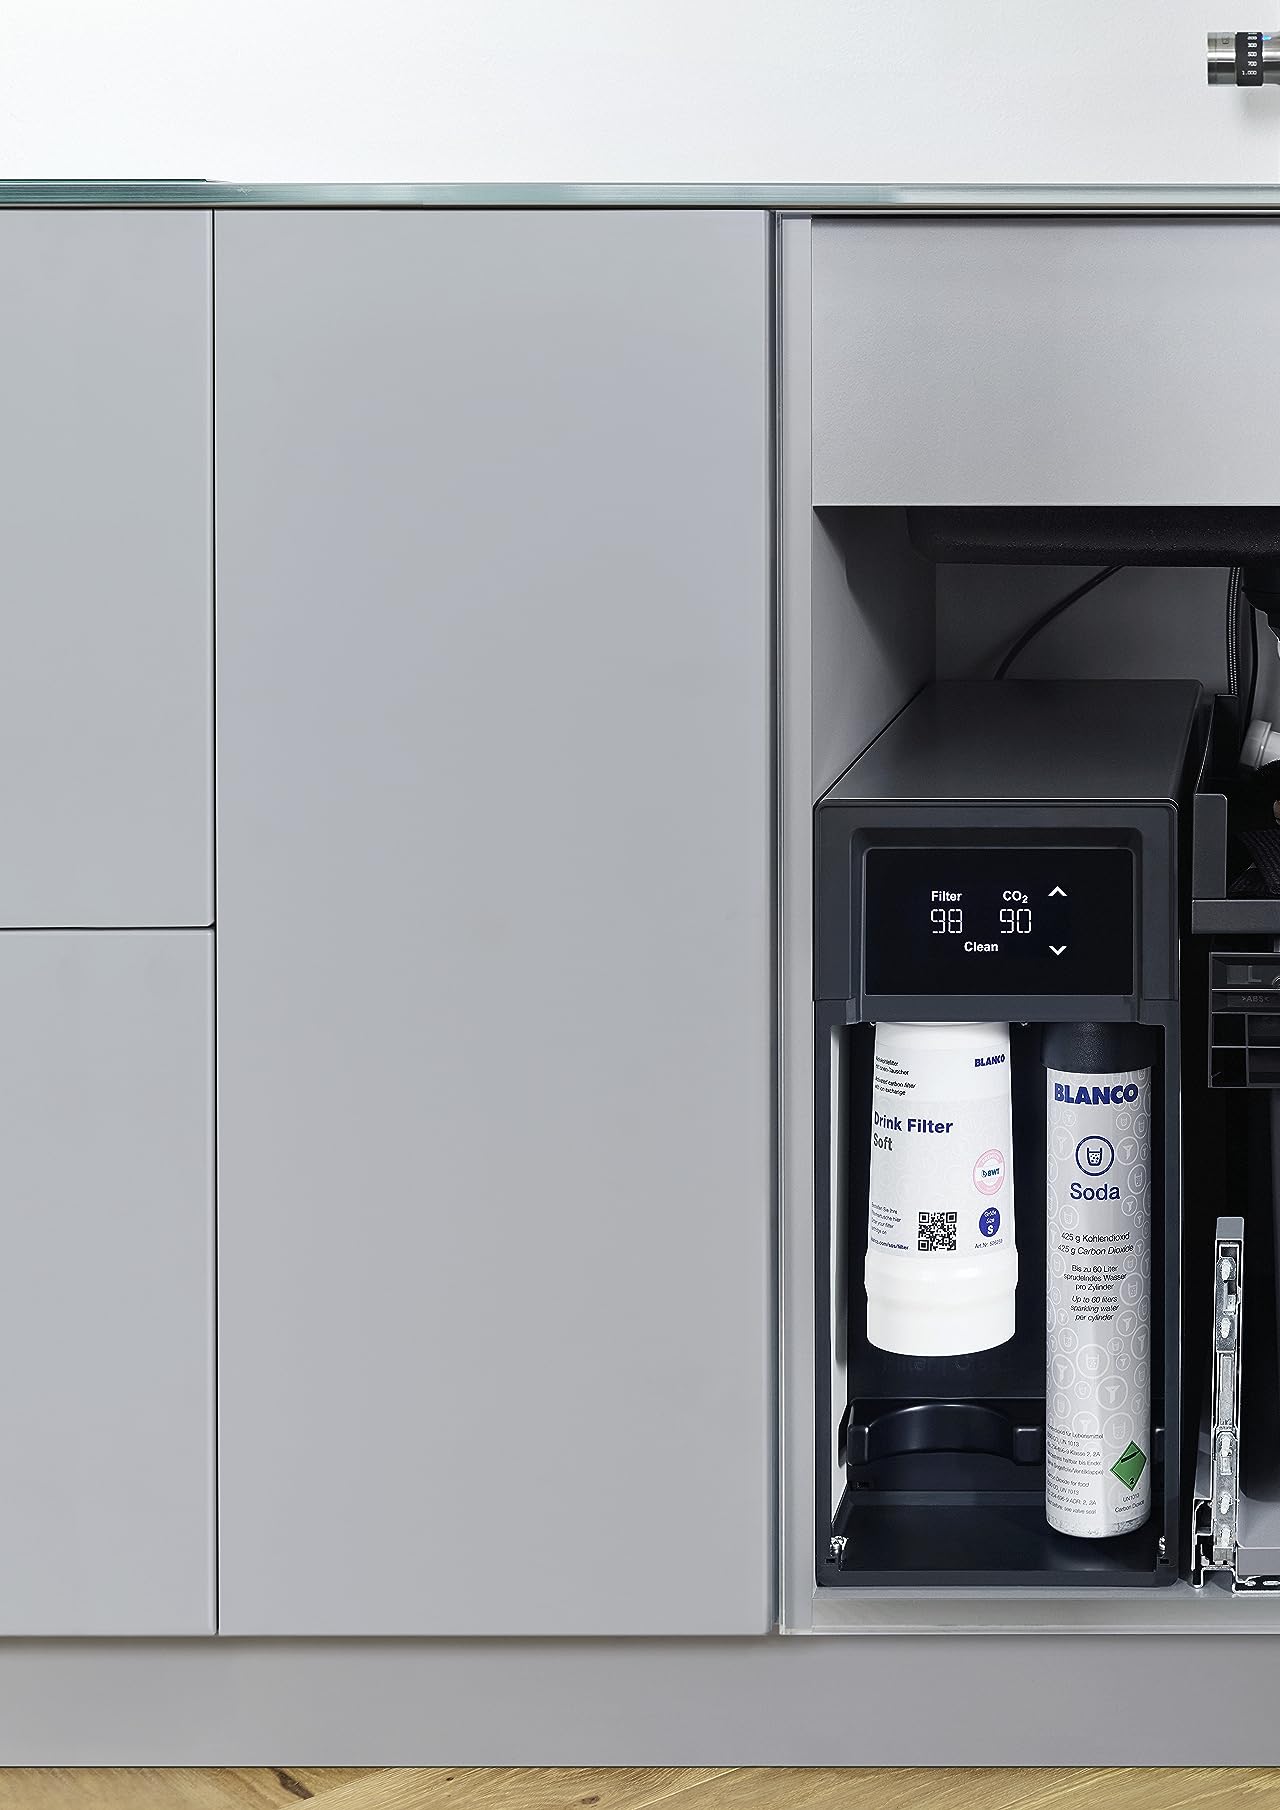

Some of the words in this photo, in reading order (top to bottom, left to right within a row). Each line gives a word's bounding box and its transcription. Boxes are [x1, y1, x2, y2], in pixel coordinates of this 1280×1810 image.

[931, 890, 963, 902] Filter
[930, 908, 963, 934] 98
[1000, 908, 1032, 934] 90
[964, 941, 999, 952] Clean
[974, 1054, 1006, 1068] BLANCO
[1054, 1082, 1139, 1105] BLANCO
[874, 1110, 902, 1132] Drink
[907, 1118, 954, 1134] Filter
[873, 1132, 893, 1152] Soft
[1070, 1182, 1121, 1201] Soda
[987, 1224, 994, 1235] S
[1074, 1234, 1080, 1243] g
[1078, 1247, 1106, 1255] Carbon
